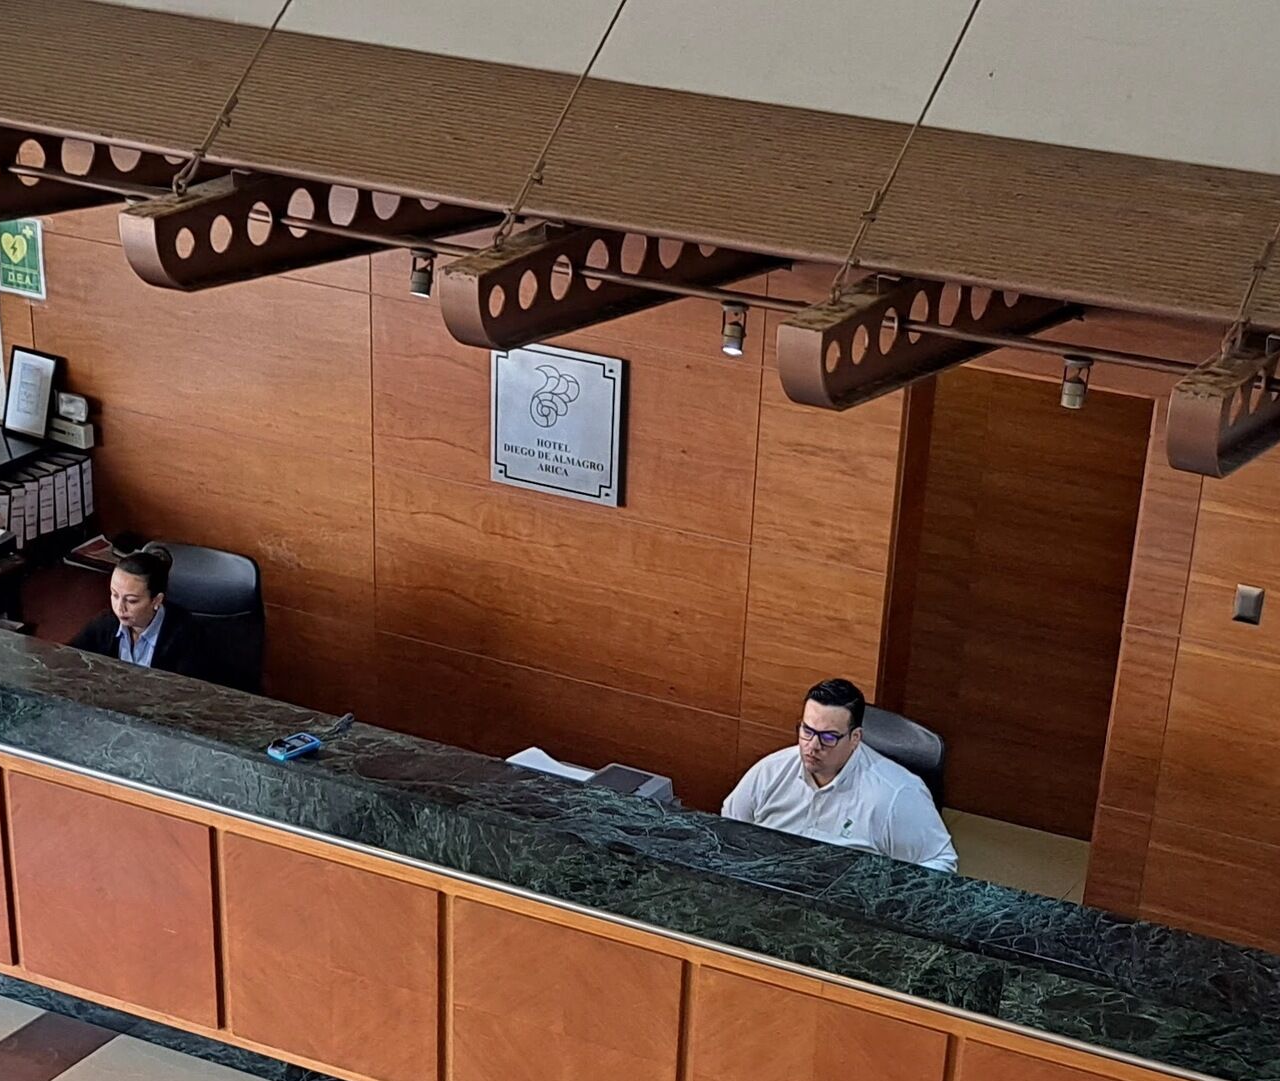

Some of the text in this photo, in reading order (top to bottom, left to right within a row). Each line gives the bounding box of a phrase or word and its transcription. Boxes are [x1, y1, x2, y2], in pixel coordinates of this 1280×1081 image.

[537, 438, 571, 452] HOTEL
[504, 443, 604, 472] DIEGO DE ALMAGRO
[537, 464, 569, 477] ARICA
